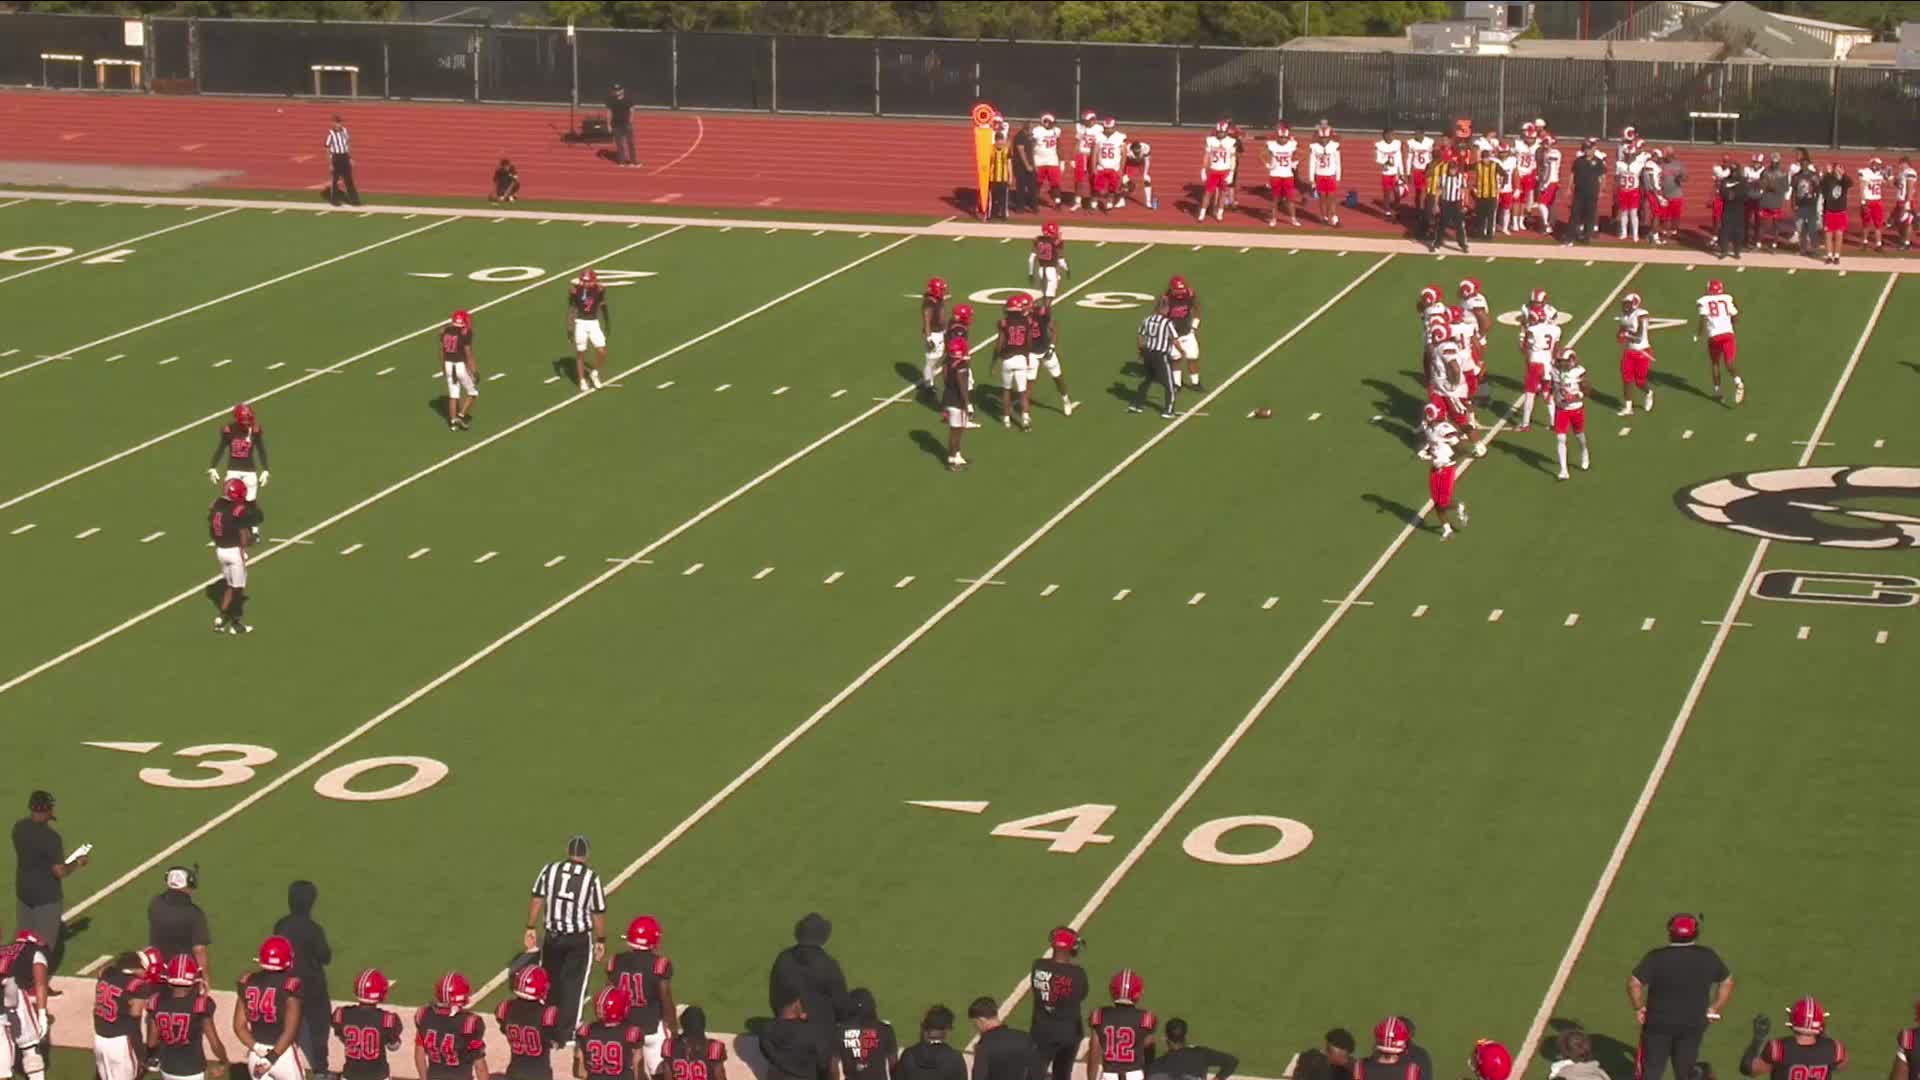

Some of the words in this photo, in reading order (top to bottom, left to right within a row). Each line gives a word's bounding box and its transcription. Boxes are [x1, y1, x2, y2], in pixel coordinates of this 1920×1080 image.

[1708, 300, 1730, 318] 87
[1544, 334, 1553, 351] 3
[139, 743, 449, 801] 30
[990, 803, 1314, 865] 40
[558, 872, 575, 899] L
[343, 1025, 380, 1060] 20
[424, 1028, 460, 1066] 44
[586, 1039, 623, 1076] 39
[1103, 1027, 1135, 1063] 12
